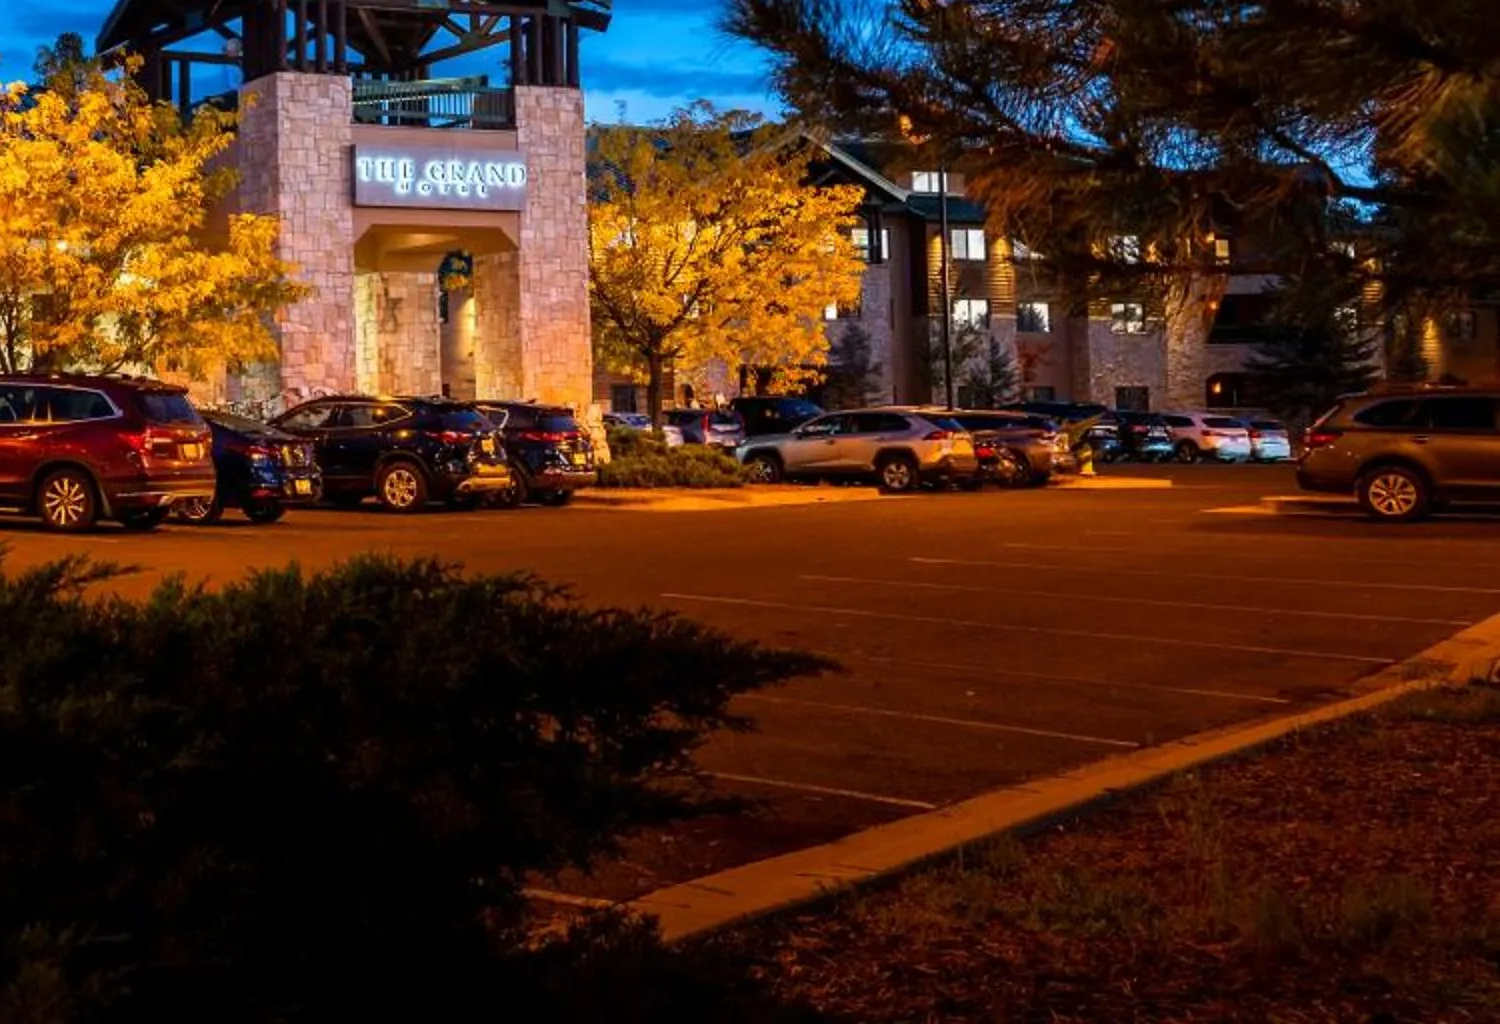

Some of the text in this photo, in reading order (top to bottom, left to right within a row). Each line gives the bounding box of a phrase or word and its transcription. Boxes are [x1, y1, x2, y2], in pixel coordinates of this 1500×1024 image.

[358, 157, 527, 187] THE GRAND
[396, 181, 487, 198] HOTEL
